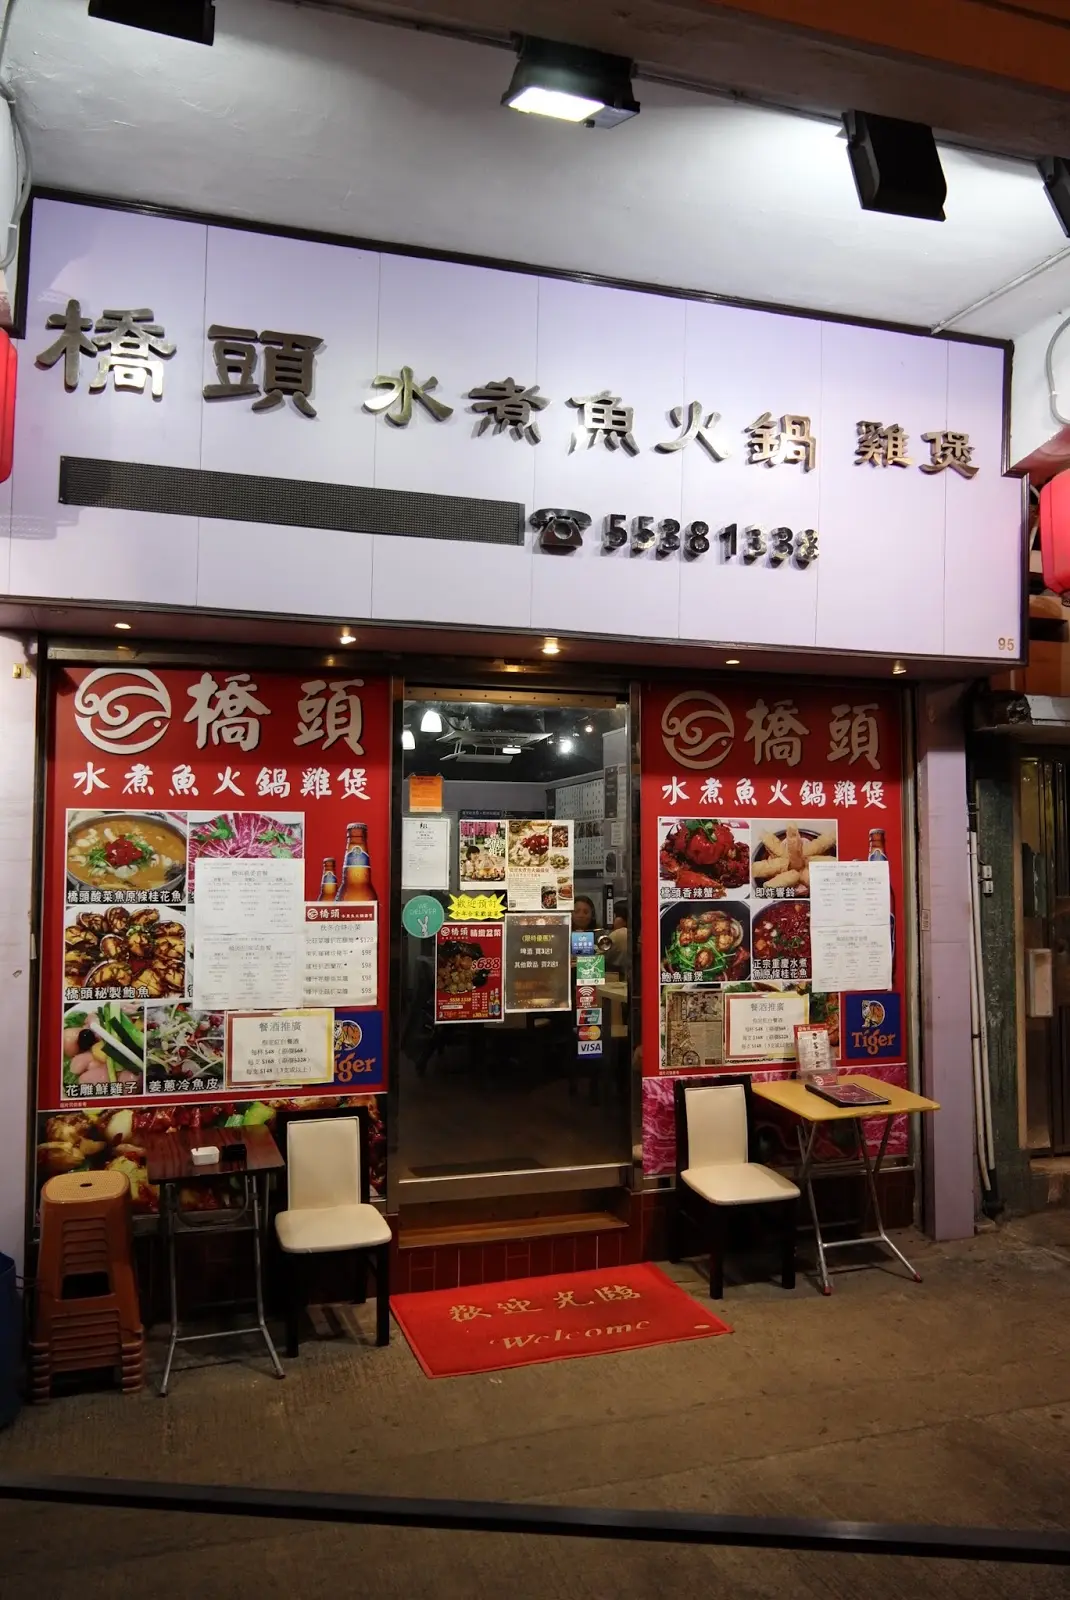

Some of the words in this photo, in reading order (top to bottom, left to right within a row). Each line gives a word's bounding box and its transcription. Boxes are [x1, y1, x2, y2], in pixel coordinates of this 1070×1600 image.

[998, 638, 1015, 651] 95
[183, 672, 365, 756] 橋頭
[744, 699, 881, 770] 橋頭
[73, 762, 371, 800] 水煮魚火鍋雞煲
[661, 776, 887, 809] 水煮魚火鍋雞煲
[660, 887, 713, 898] 橋頭香辣蟹
[471, 957, 500, 970] $688
[259, 1021, 302, 1032] 餐酒推廣
[580, 1043, 601, 1052] VISA
[851, 1030, 896, 1055] Tiger
